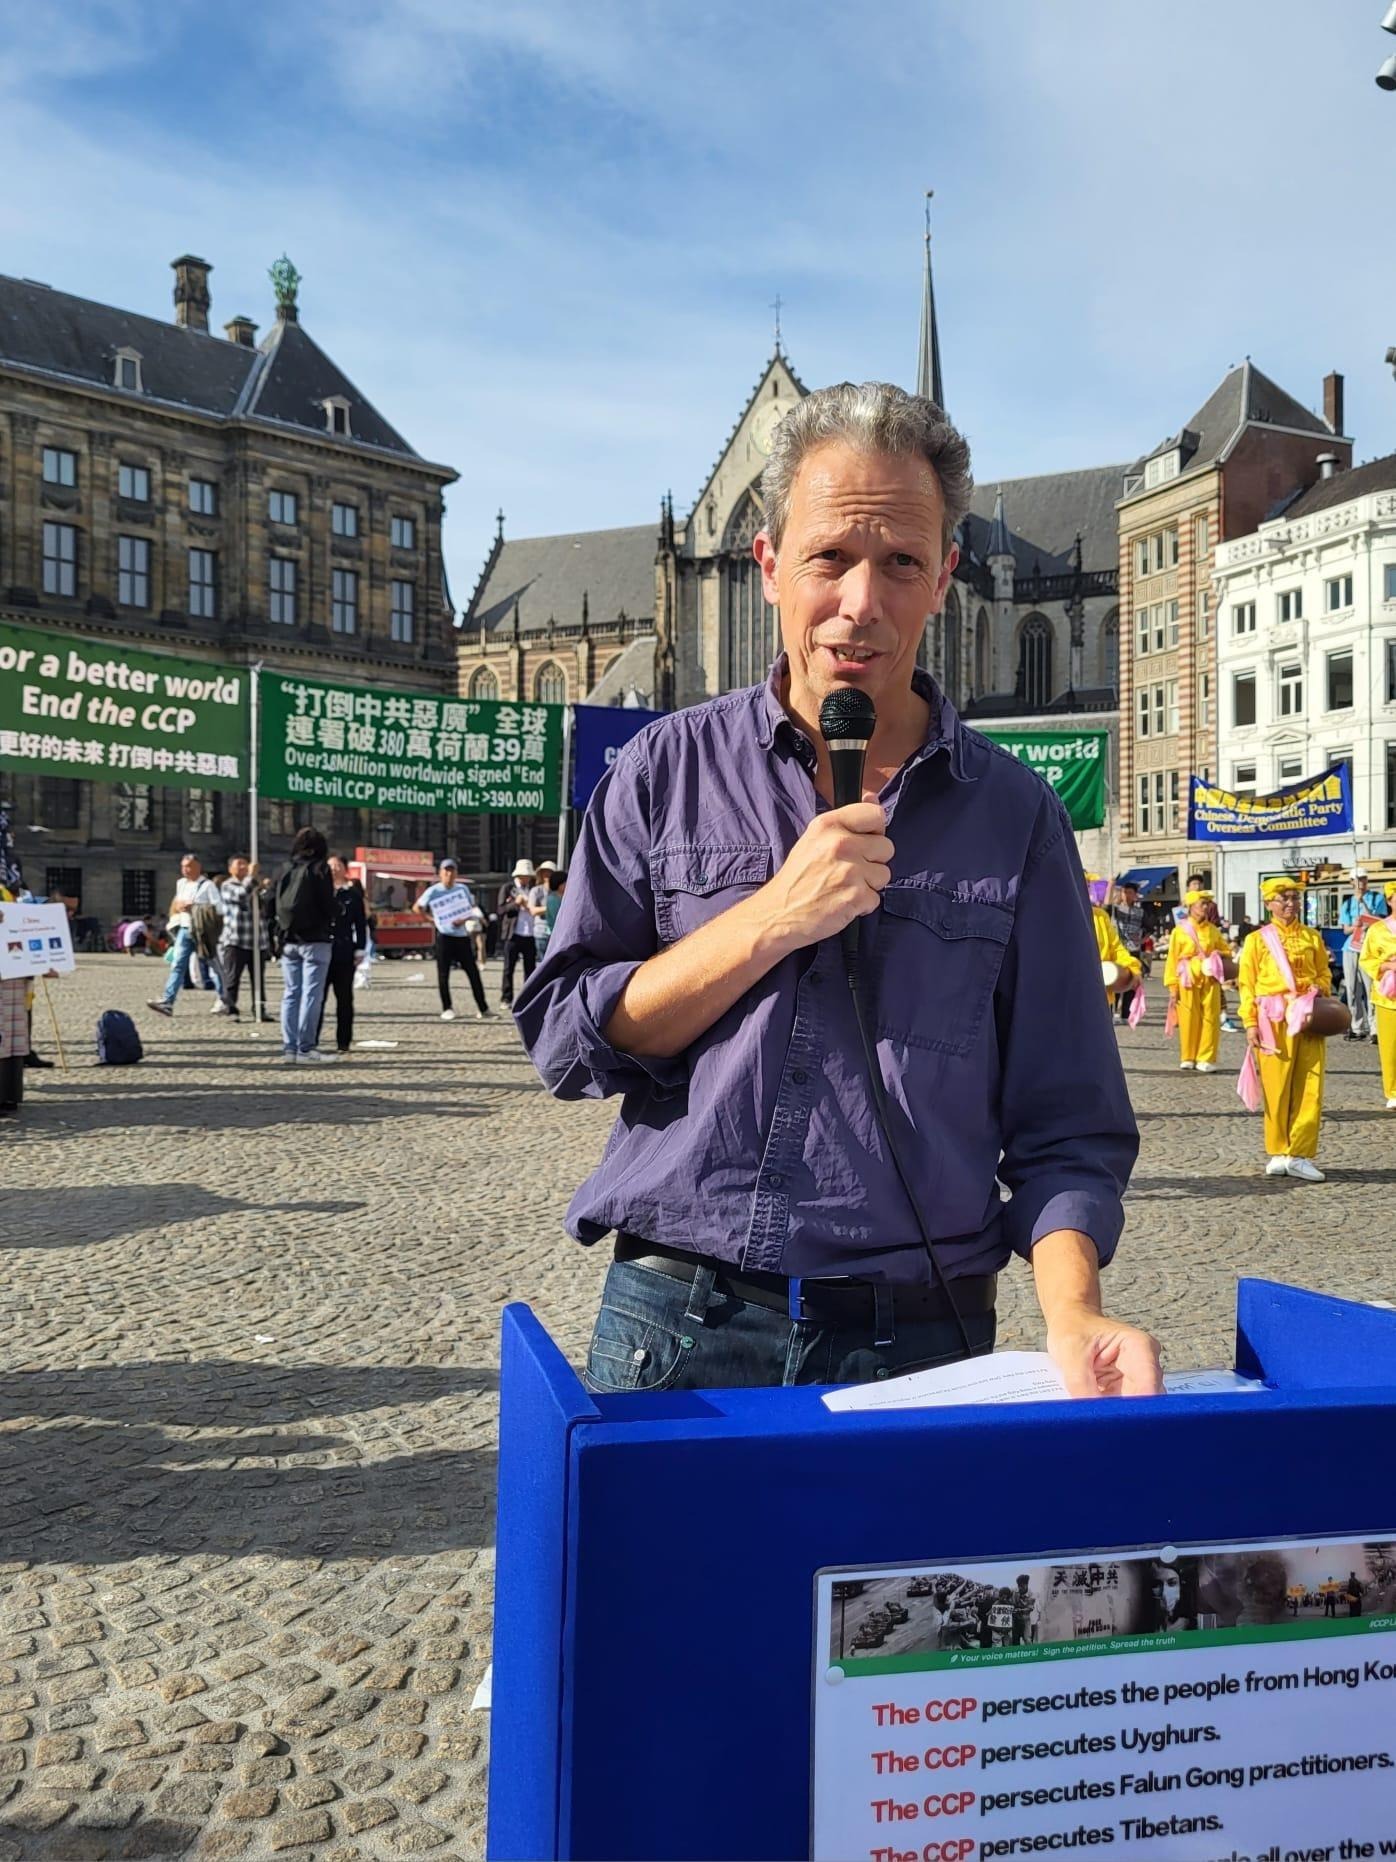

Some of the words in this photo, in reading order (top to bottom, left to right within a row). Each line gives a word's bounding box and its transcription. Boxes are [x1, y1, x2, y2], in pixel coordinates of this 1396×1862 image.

[39, 654, 60, 678] a
[66, 651, 159, 694] better
[164, 676, 241, 705] world
[22, 685, 83, 720] End
[87, 697, 136, 727] the
[141, 705, 196, 734] CCP
[495, 706, 548, 736] 全球
[1026, 737, 1100, 762] world
[287, 772, 313, 792] the
[314, 776, 343, 797] Evil
[344, 782, 375, 800] CCP
[377, 784, 444, 807] petition"
[390, 762, 465, 785] worldwide
[467, 765, 511, 788] signed
[1258, 817, 1328, 832] Committee
[1309, 803, 1344, 815] Party
[961, 1654, 980, 1663] Your
[981, 1653, 1004, 1661] voice
[1005, 1650, 1039, 1660] matters!
[1043, 1647, 1061, 1657] Sign
[1062, 1646, 1075, 1655] the
[1075, 1643, 1107, 1655] petition.
[1109, 1639, 1139, 1650] Spread
[1141, 1638, 1154, 1647] the
[1155, 1636, 1176, 1646] truth
[871, 1702, 920, 1726] The
[925, 1698, 977, 1722] CCP
[982, 1687, 1117, 1723] persecutes
[1121, 1681, 1159, 1703] the
[1164, 1673, 1240, 1705] people
[1245, 1671, 1299, 1692] from
[1303, 1667, 1359, 1688] Hong
[1364, 1660, 1396, 1682] Ko
[871, 1750, 919, 1774] The
[924, 1745, 976, 1770] CCP
[980, 1733, 1116, 1770] persecutes
[1121, 1724, 1221, 1753] Uyghurs.
[870, 1798, 918, 1823] The
[923, 1791, 976, 1817] CCP
[980, 1779, 1115, 1816] persecutes
[1120, 1771, 1181, 1795] Falun
[1185, 1766, 1244, 1788] Gong
[1249, 1752, 1395, 1786] practitioners.
[870, 1846, 918, 1862] The
[923, 1839, 975, 1862] CCP
[979, 1825, 1114, 1862] persecutes
[1119, 1814, 1224, 1840] Tibetans.
[1339, 1838, 1374, 1860] the
